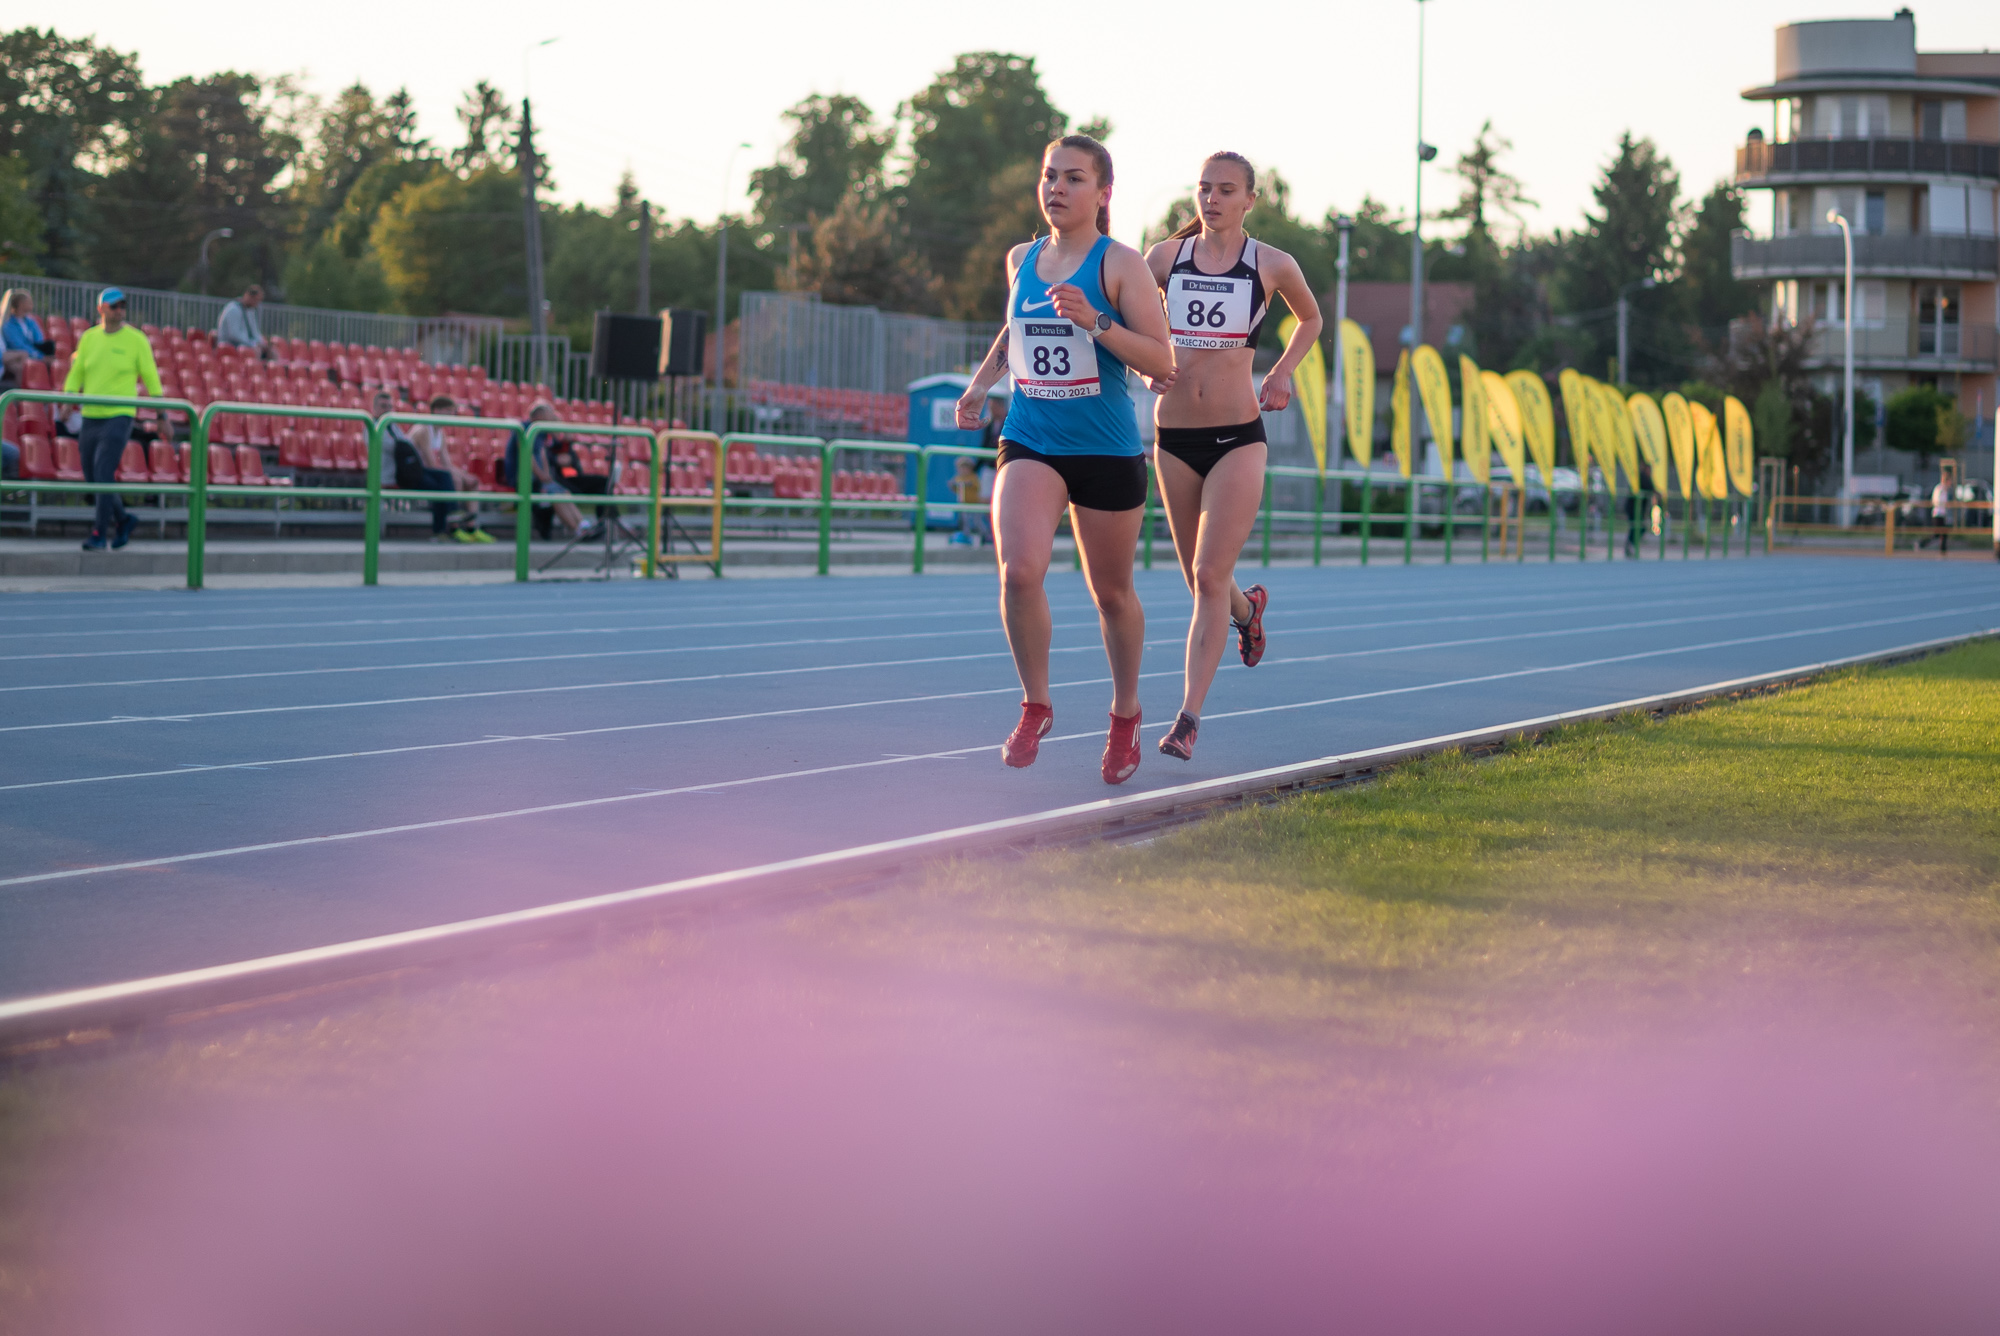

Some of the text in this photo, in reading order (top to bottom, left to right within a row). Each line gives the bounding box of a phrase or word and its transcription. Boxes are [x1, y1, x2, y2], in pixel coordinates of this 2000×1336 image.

[1189, 281, 1227, 292] Dr Irena Eris
[1187, 300, 1226, 328] 86
[1031, 326, 1066, 335] Dr Irena Eris
[1176, 338, 1217, 348] PIASECZNO
[1033, 345, 1070, 376] 83
[1069, 387, 1090, 397] 2021
